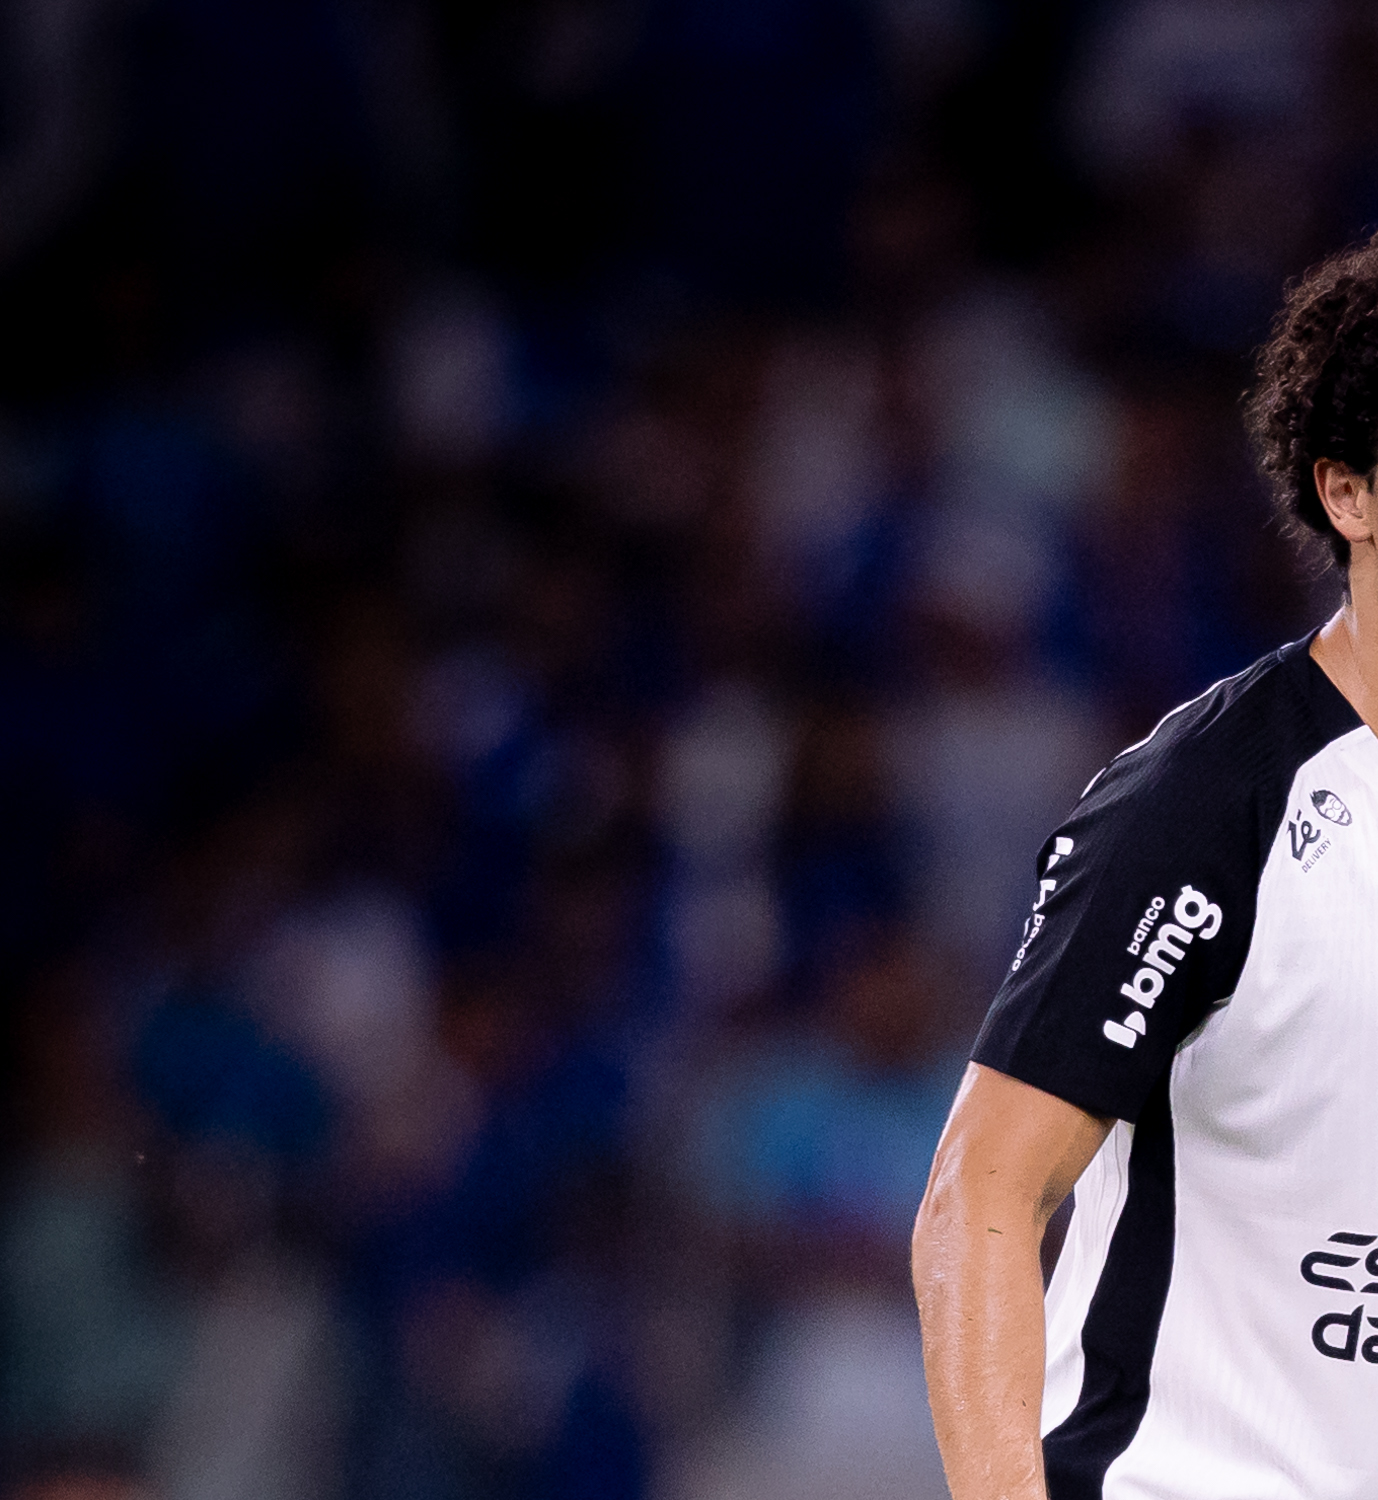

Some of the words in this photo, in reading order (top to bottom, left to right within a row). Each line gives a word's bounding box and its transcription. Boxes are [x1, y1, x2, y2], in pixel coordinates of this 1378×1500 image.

[1301, 838, 1332, 873] DELIVERY
[1120, 884, 1223, 1009] bmg
[1127, 896, 1166, 956] banco
